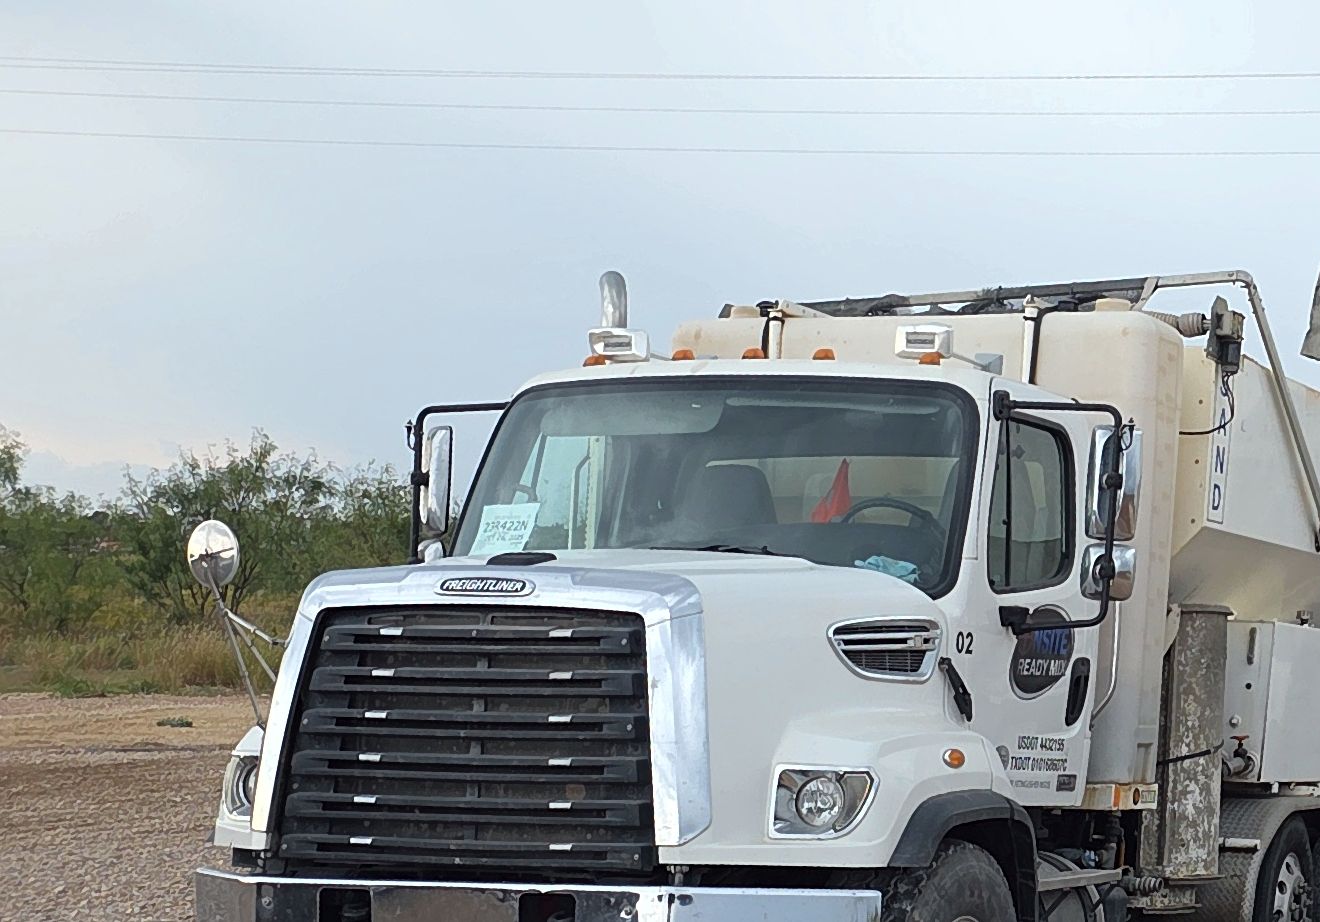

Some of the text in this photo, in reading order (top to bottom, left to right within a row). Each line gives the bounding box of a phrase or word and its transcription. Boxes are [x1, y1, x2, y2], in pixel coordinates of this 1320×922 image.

[442, 579, 524, 592] FREIGHTLINER
[956, 631, 974, 655] 02
[1017, 659, 1066, 677] READY MIX
[1017, 735, 1039, 751] USDOT
[1009, 756, 1031, 771] TXDOT
